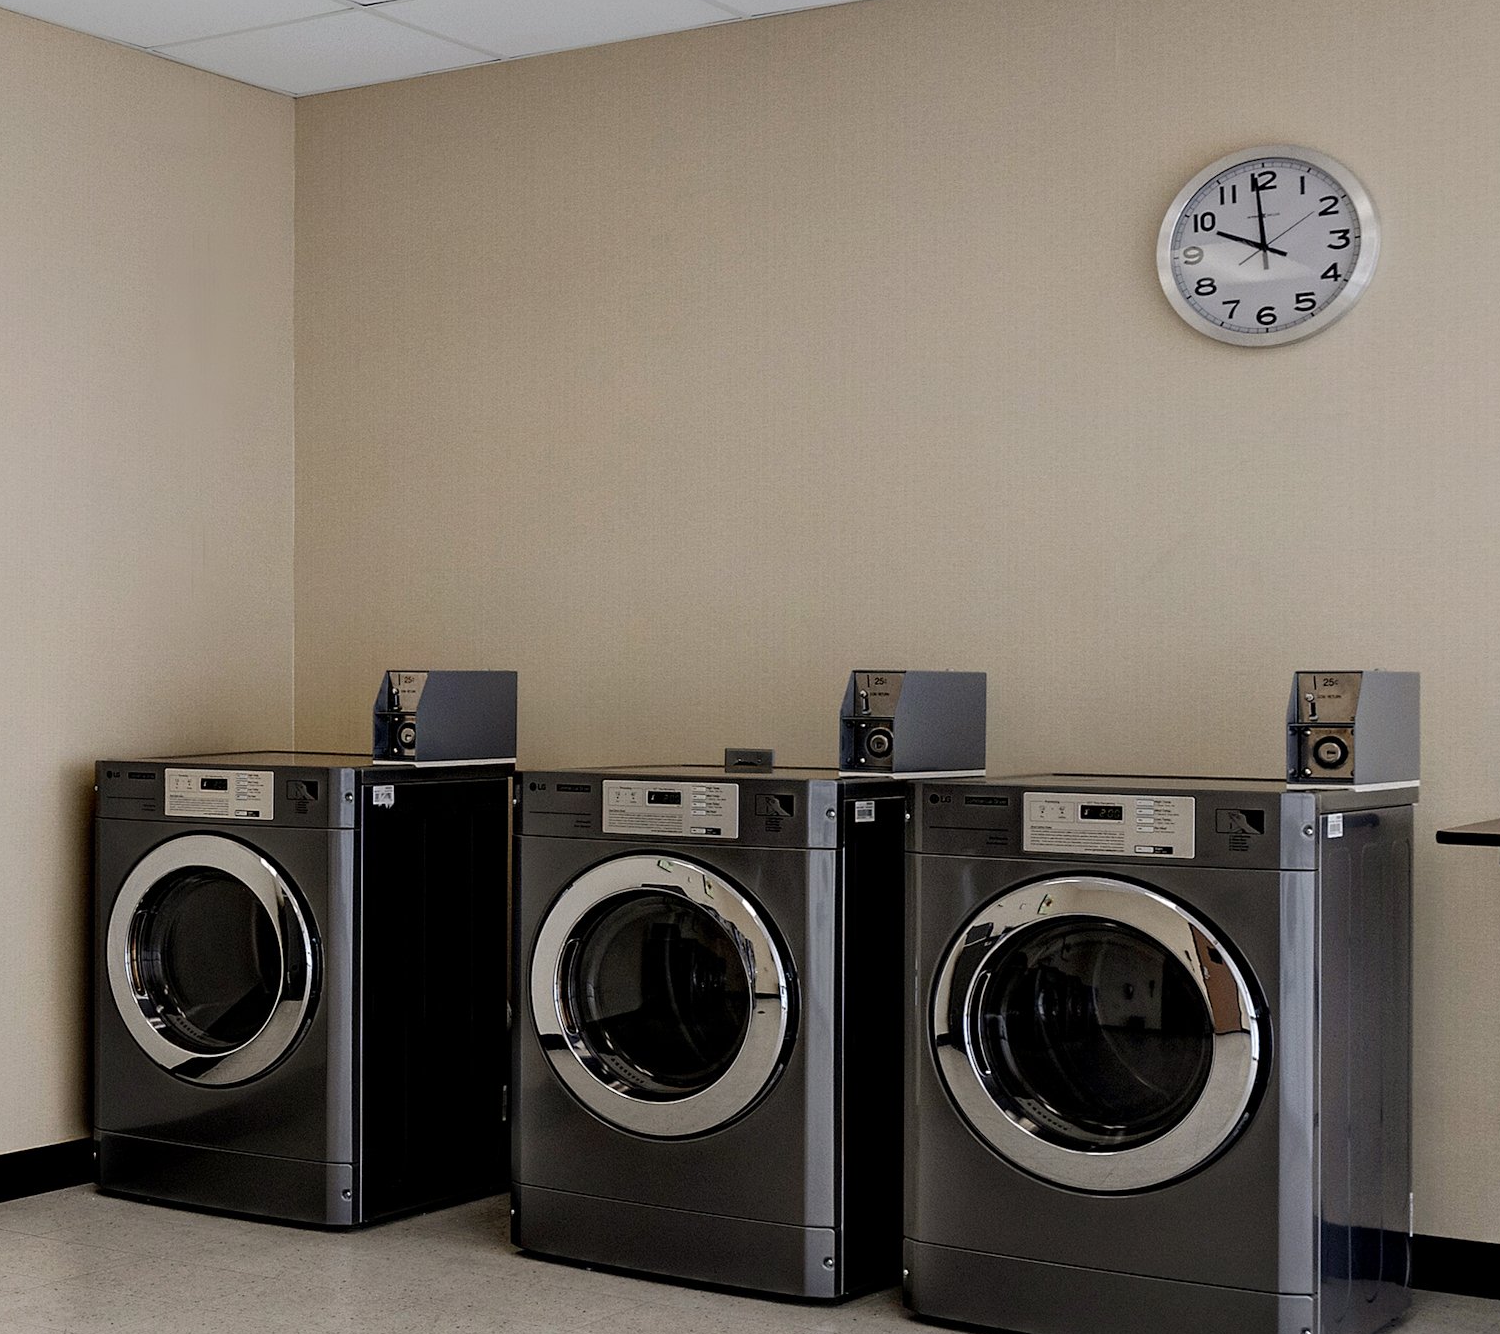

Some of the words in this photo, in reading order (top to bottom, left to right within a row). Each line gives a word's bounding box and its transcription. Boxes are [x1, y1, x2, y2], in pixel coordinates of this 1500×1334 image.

[1250, 171, 1276, 191] 12
[1300, 176, 1305, 194] 1
[1220, 185, 1237, 205] 11
[1319, 196, 1338, 217] 2
[1194, 212, 1216, 233] 10
[1328, 229, 1350, 249] 3
[1183, 247, 1203, 265] 9
[1321, 263, 1341, 281] 4
[1195, 278, 1216, 295] 8
[1223, 300, 1240, 319] 7
[1294, 292, 1316, 311] 5
[1256, 307, 1276, 325] 6
